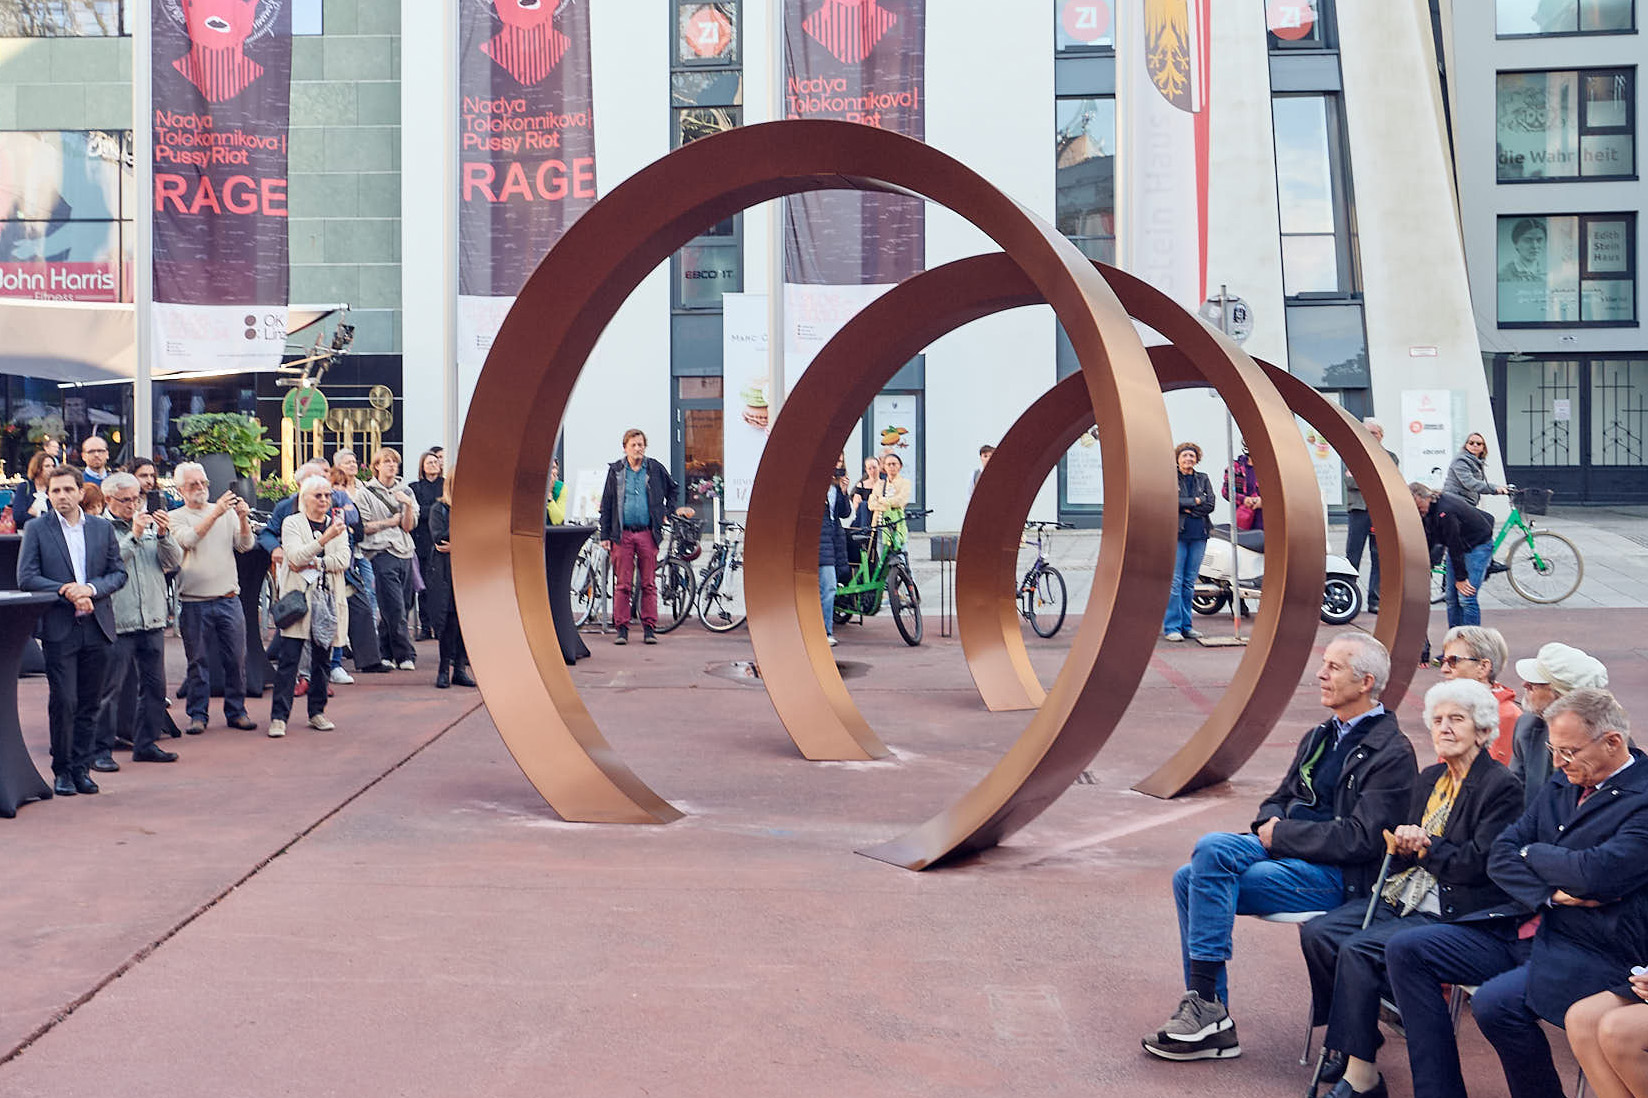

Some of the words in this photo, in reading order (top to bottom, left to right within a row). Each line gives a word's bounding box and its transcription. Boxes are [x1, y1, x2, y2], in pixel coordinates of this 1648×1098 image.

[787, 75, 847, 97] Nadya
[463, 95, 526, 116] Nadya
[786, 91, 912, 113] Tolokonnikova
[156, 109, 213, 132] Nadya
[462, 111, 586, 132] Tolokonnikova
[155, 126, 279, 150] Tolokonnikova
[463, 132, 522, 154] Pussy
[525, 130, 561, 149] Riot
[156, 144, 211, 168] Pussy
[211, 146, 250, 165] Riot
[1498, 150, 1526, 165] die
[463, 157, 596, 202] RAGE
[155, 173, 288, 216] RAGE
[50, 267, 115, 290] Harris
